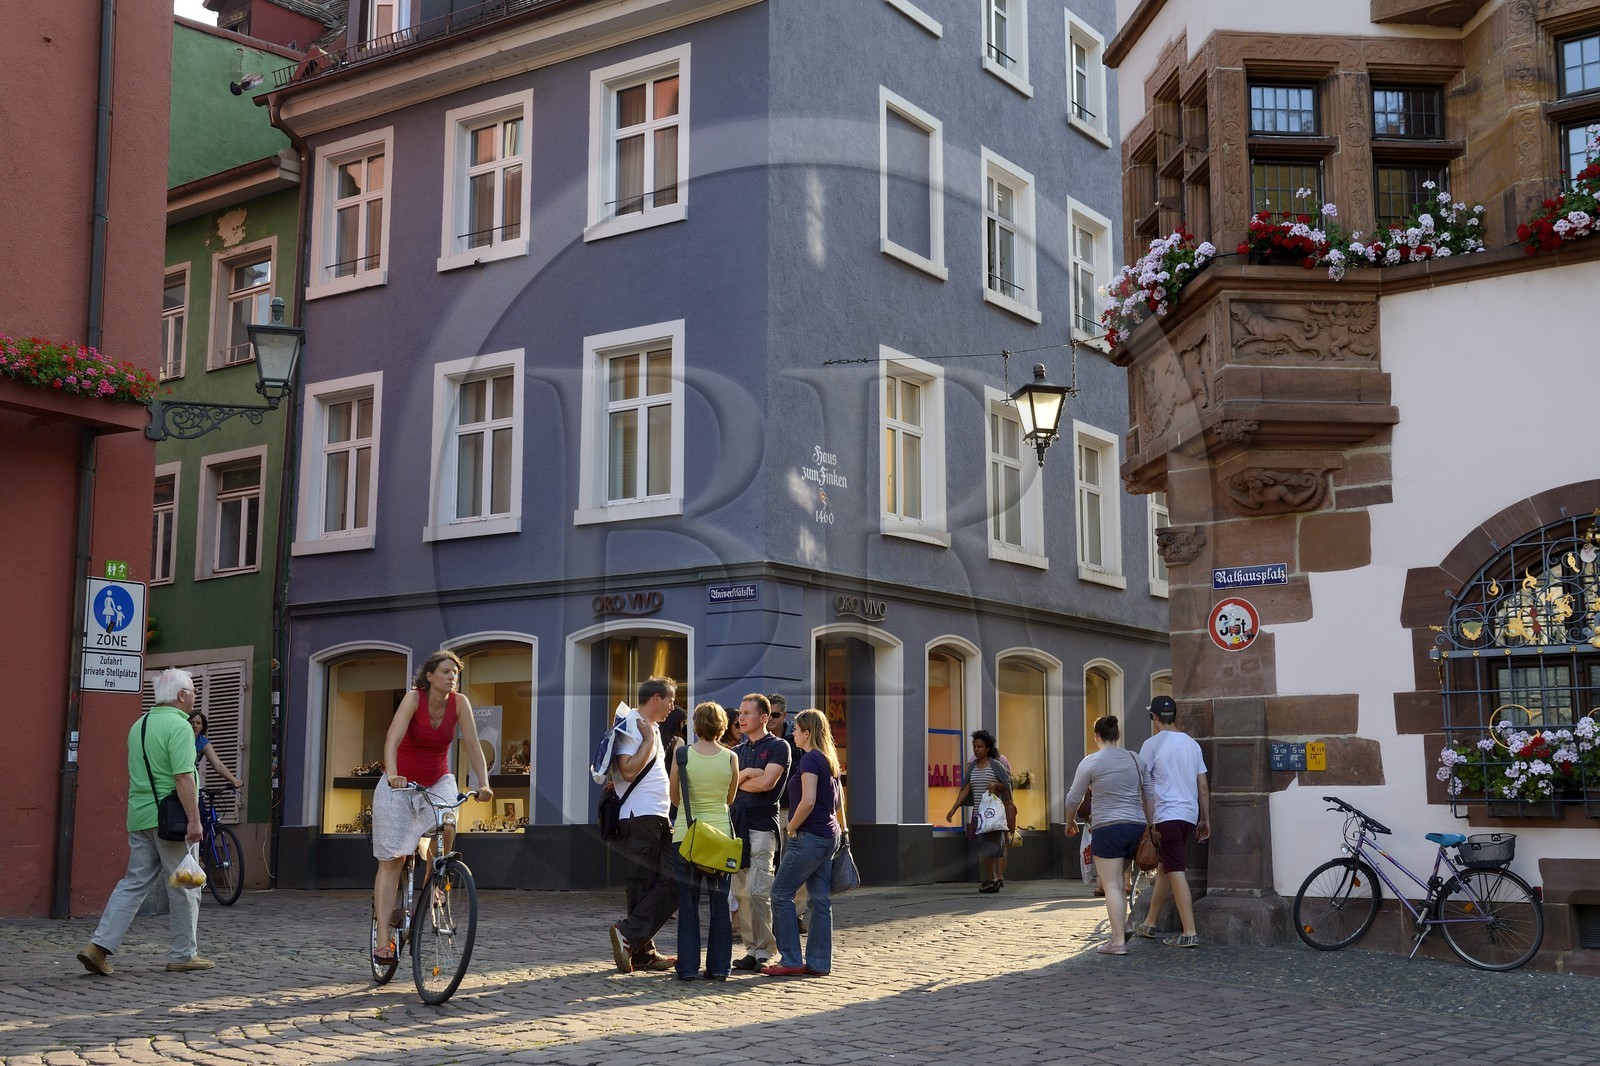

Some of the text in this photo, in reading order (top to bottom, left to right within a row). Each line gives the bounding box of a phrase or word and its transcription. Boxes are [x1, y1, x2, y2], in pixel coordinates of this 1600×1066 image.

[812, 445, 837, 465] Haus
[801, 466, 848, 488] zum Finken
[815, 510, 834, 525] 1460
[1215, 567, 1285, 585] Rathausplatz
[592, 591, 664, 612] ORO VIVO
[835, 595, 888, 617] ORO VIVO
[96, 634, 128, 647] ZONE
[100, 655, 123, 666] Zufahrt
[84, 667, 138, 679] private Stellplätze
[104, 679, 116, 688] frei
